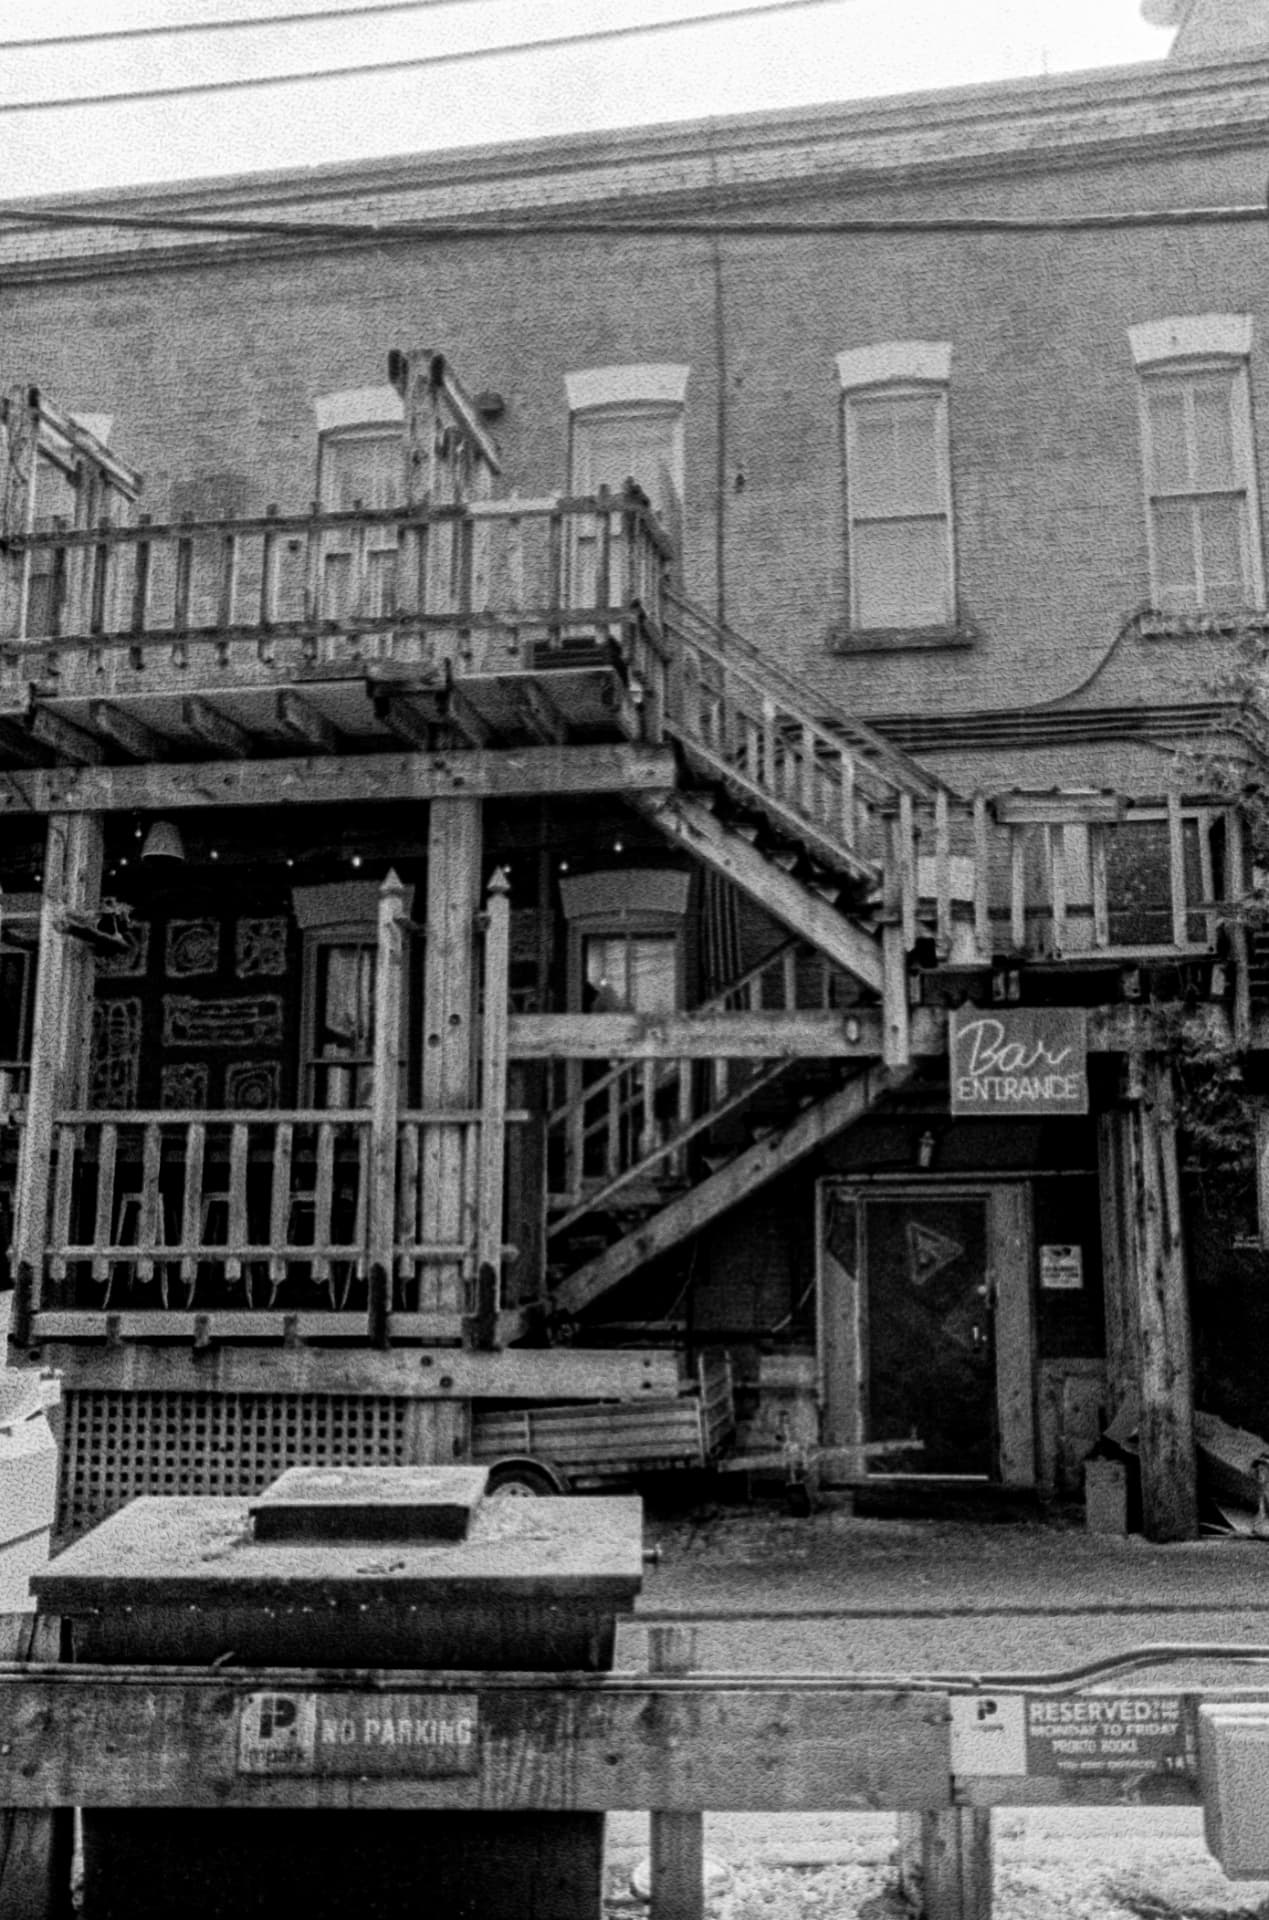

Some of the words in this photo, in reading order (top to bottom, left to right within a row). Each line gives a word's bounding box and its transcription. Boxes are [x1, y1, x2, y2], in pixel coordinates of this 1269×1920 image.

[957, 1019, 1072, 1076] Bar
[958, 1076, 1079, 1100] ENTRANCE
[321, 1719, 356, 1744] NO
[364, 1719, 471, 1744] PARKING
[1031, 1725, 1097, 1736] MONDAY
[1102, 1724, 1123, 1736] TO
[1126, 1723, 1178, 1736] FRIDAY
